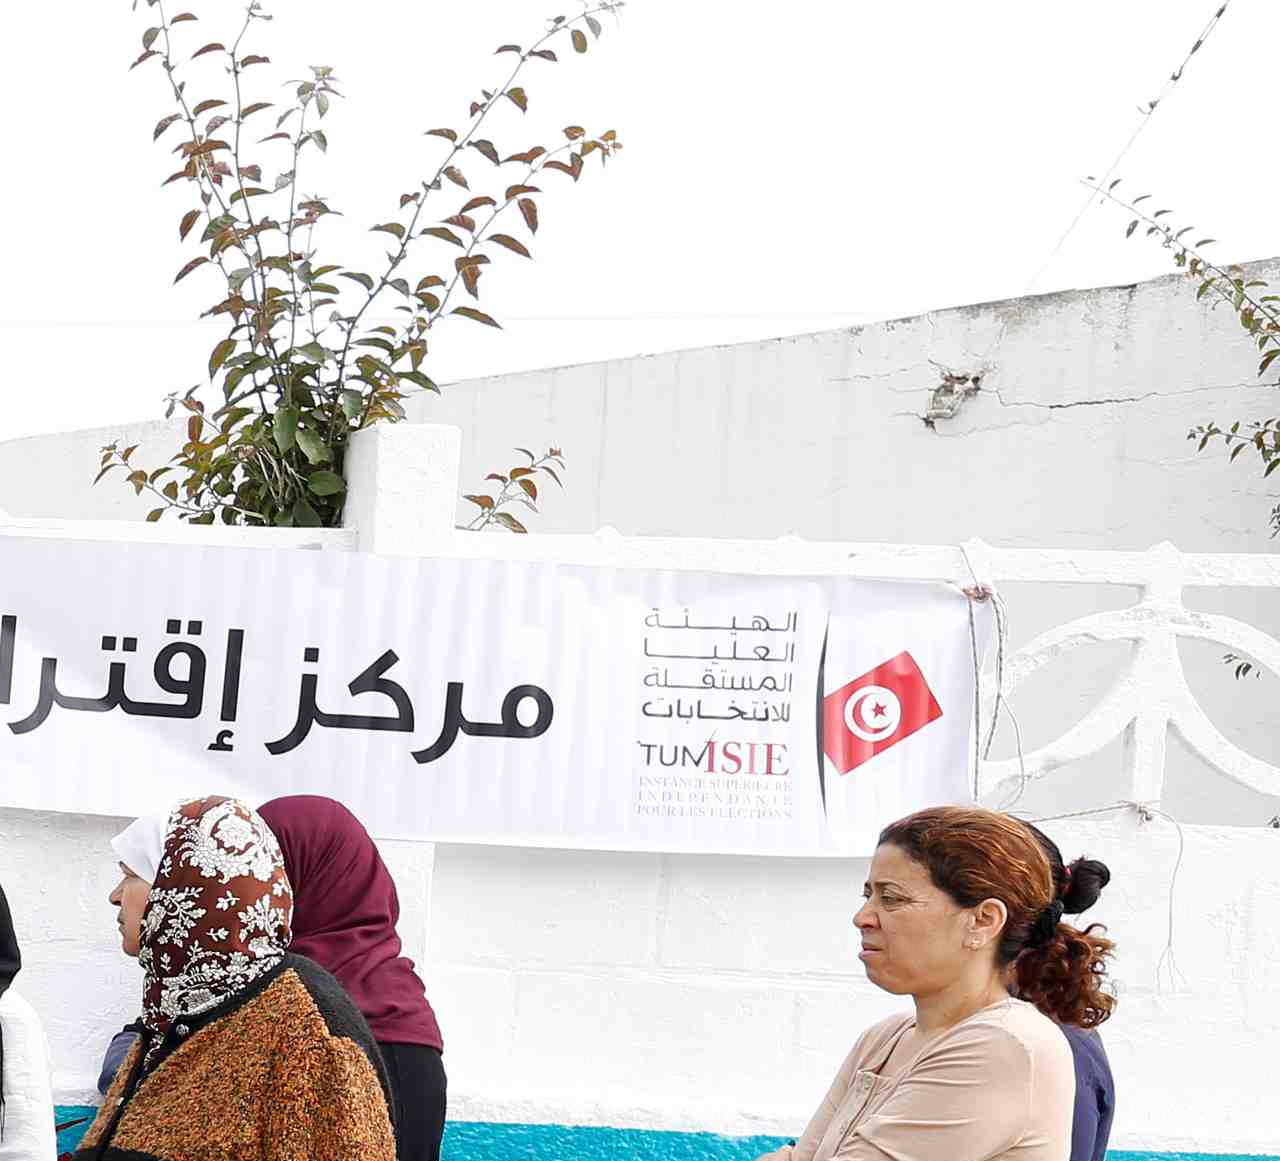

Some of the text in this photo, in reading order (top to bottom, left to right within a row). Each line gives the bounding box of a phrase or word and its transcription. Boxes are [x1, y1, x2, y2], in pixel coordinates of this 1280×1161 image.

[644, 608, 797, 636] الهيئة
[644, 637, 795, 664] العليا
[643, 667, 792, 692] المستقلة
[264, 647, 554, 764] مركز
